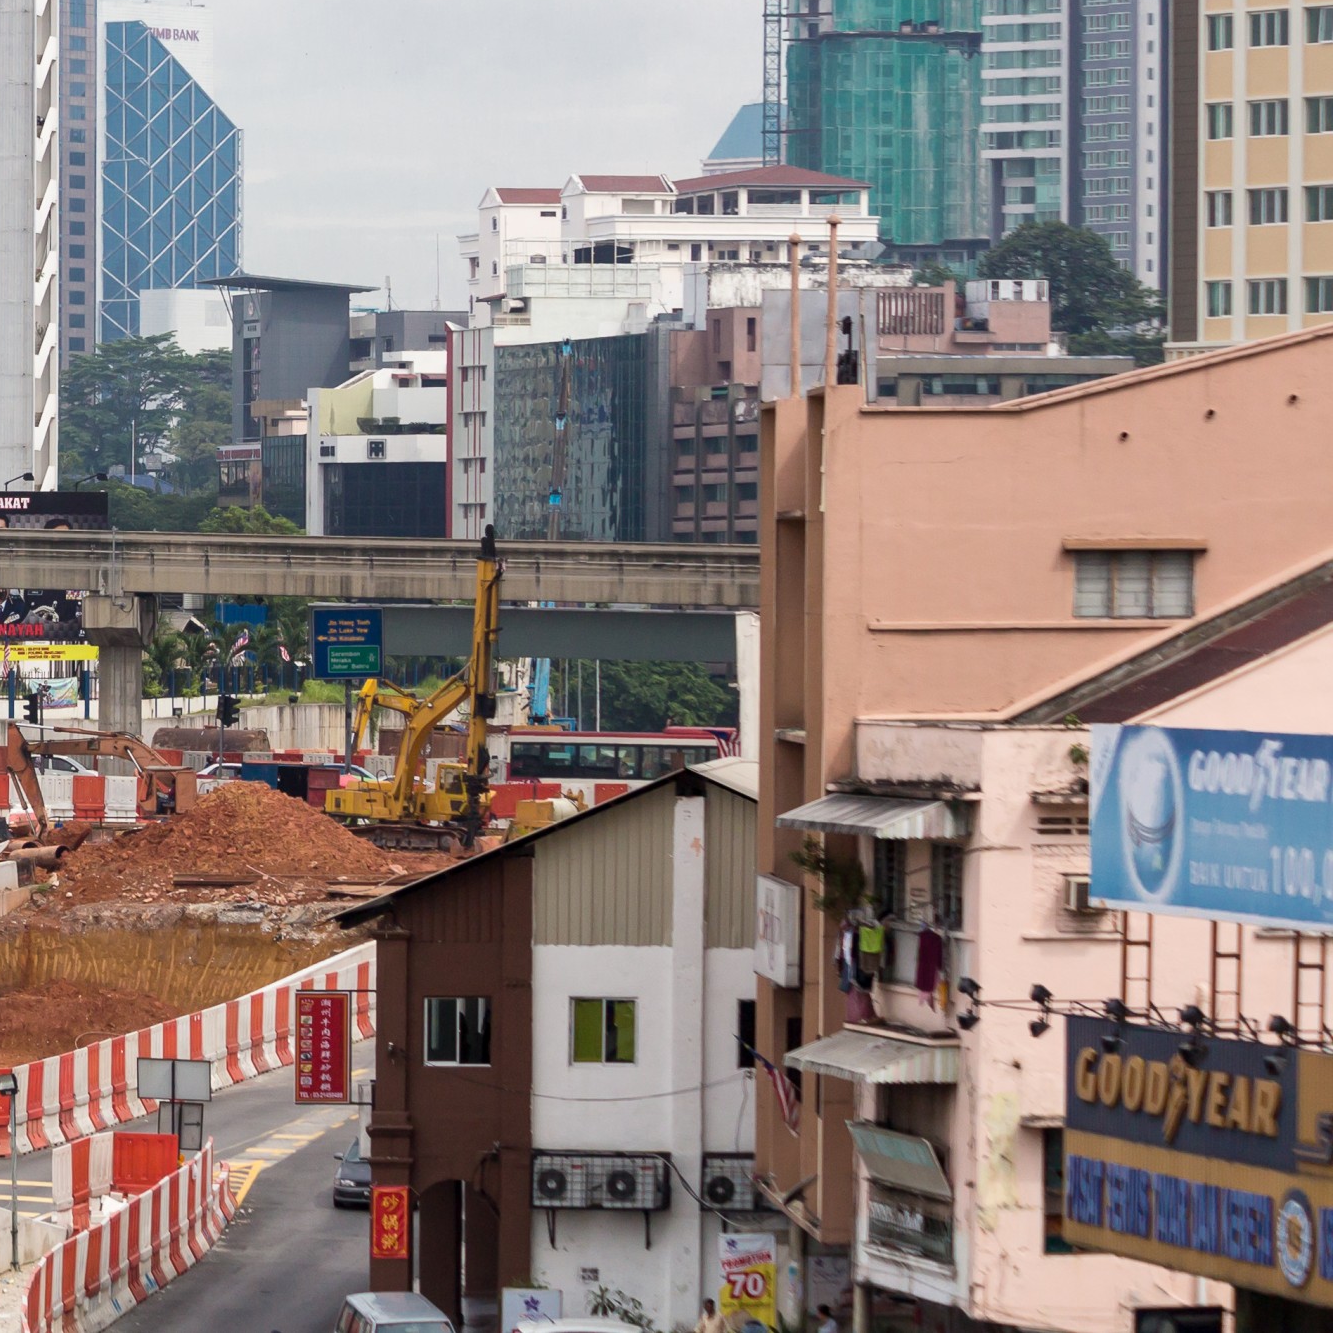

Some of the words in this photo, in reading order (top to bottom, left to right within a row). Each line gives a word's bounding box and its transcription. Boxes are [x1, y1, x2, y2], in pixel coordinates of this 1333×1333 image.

[173, 28, 200, 42] BANK
[1188, 739, 1331, 813] GOODYEAR
[1076, 1047, 1281, 1142] GOODYEAR
[728, 1272, 765, 1299] 70
